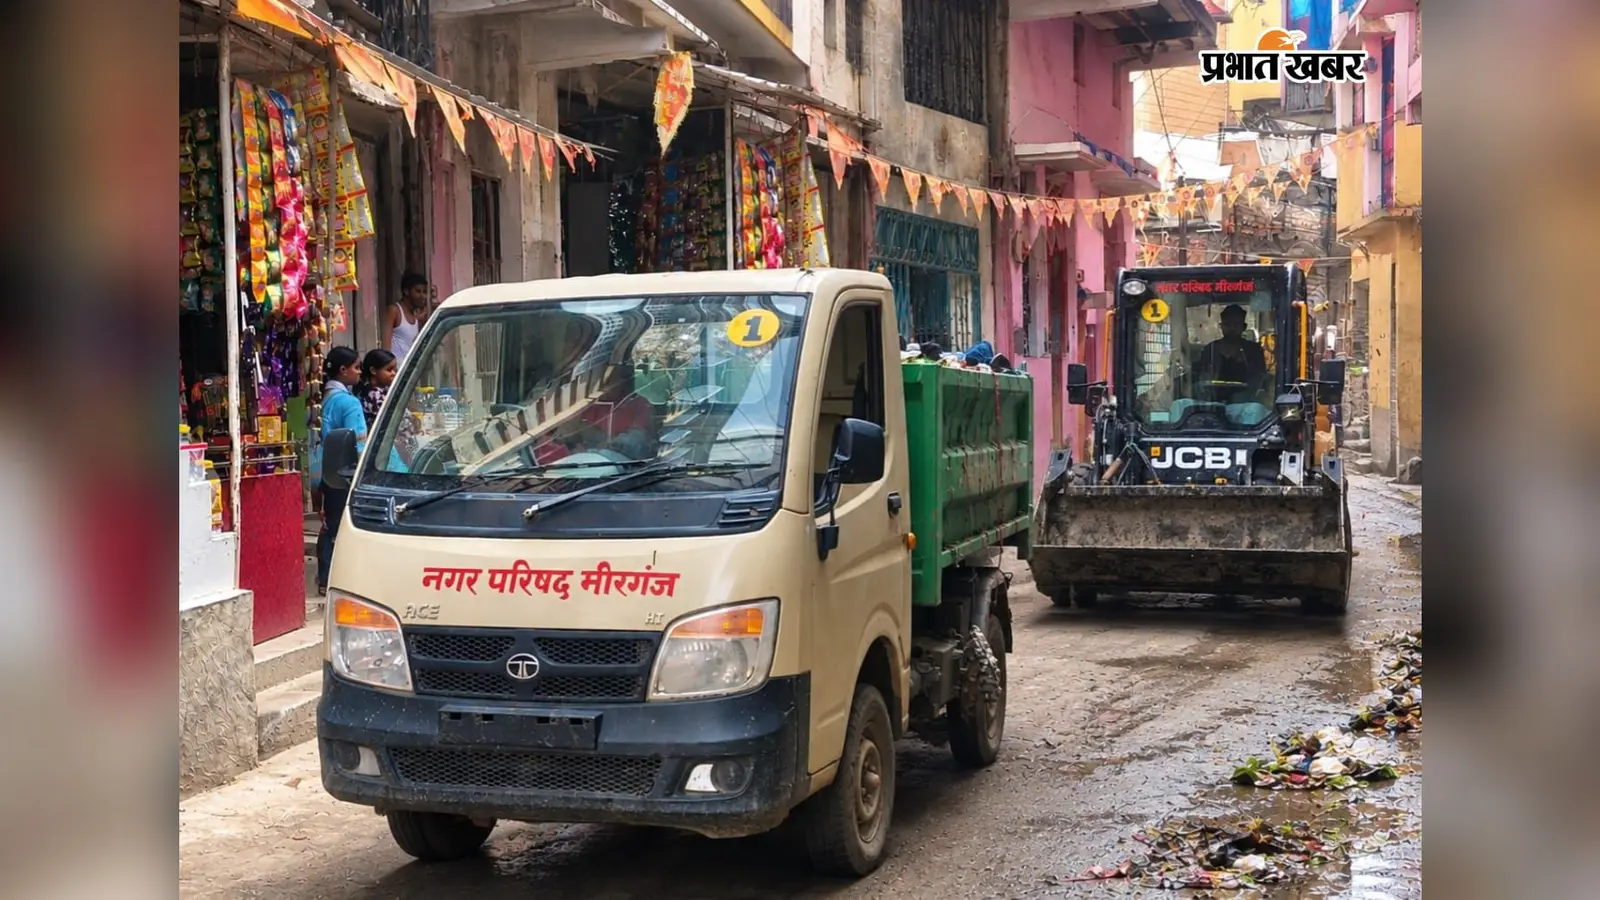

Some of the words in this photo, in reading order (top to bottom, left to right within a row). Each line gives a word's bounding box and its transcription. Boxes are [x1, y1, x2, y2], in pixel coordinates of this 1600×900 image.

[1150, 303, 1161, 318] 1
[742, 315, 763, 342] 1
[1150, 446, 1232, 470] JCB
[422, 567, 483, 595] नगर
[488, 559, 574, 600] परिषद
[581, 560, 681, 597] मीरगंज
[403, 603, 441, 620] ACE
